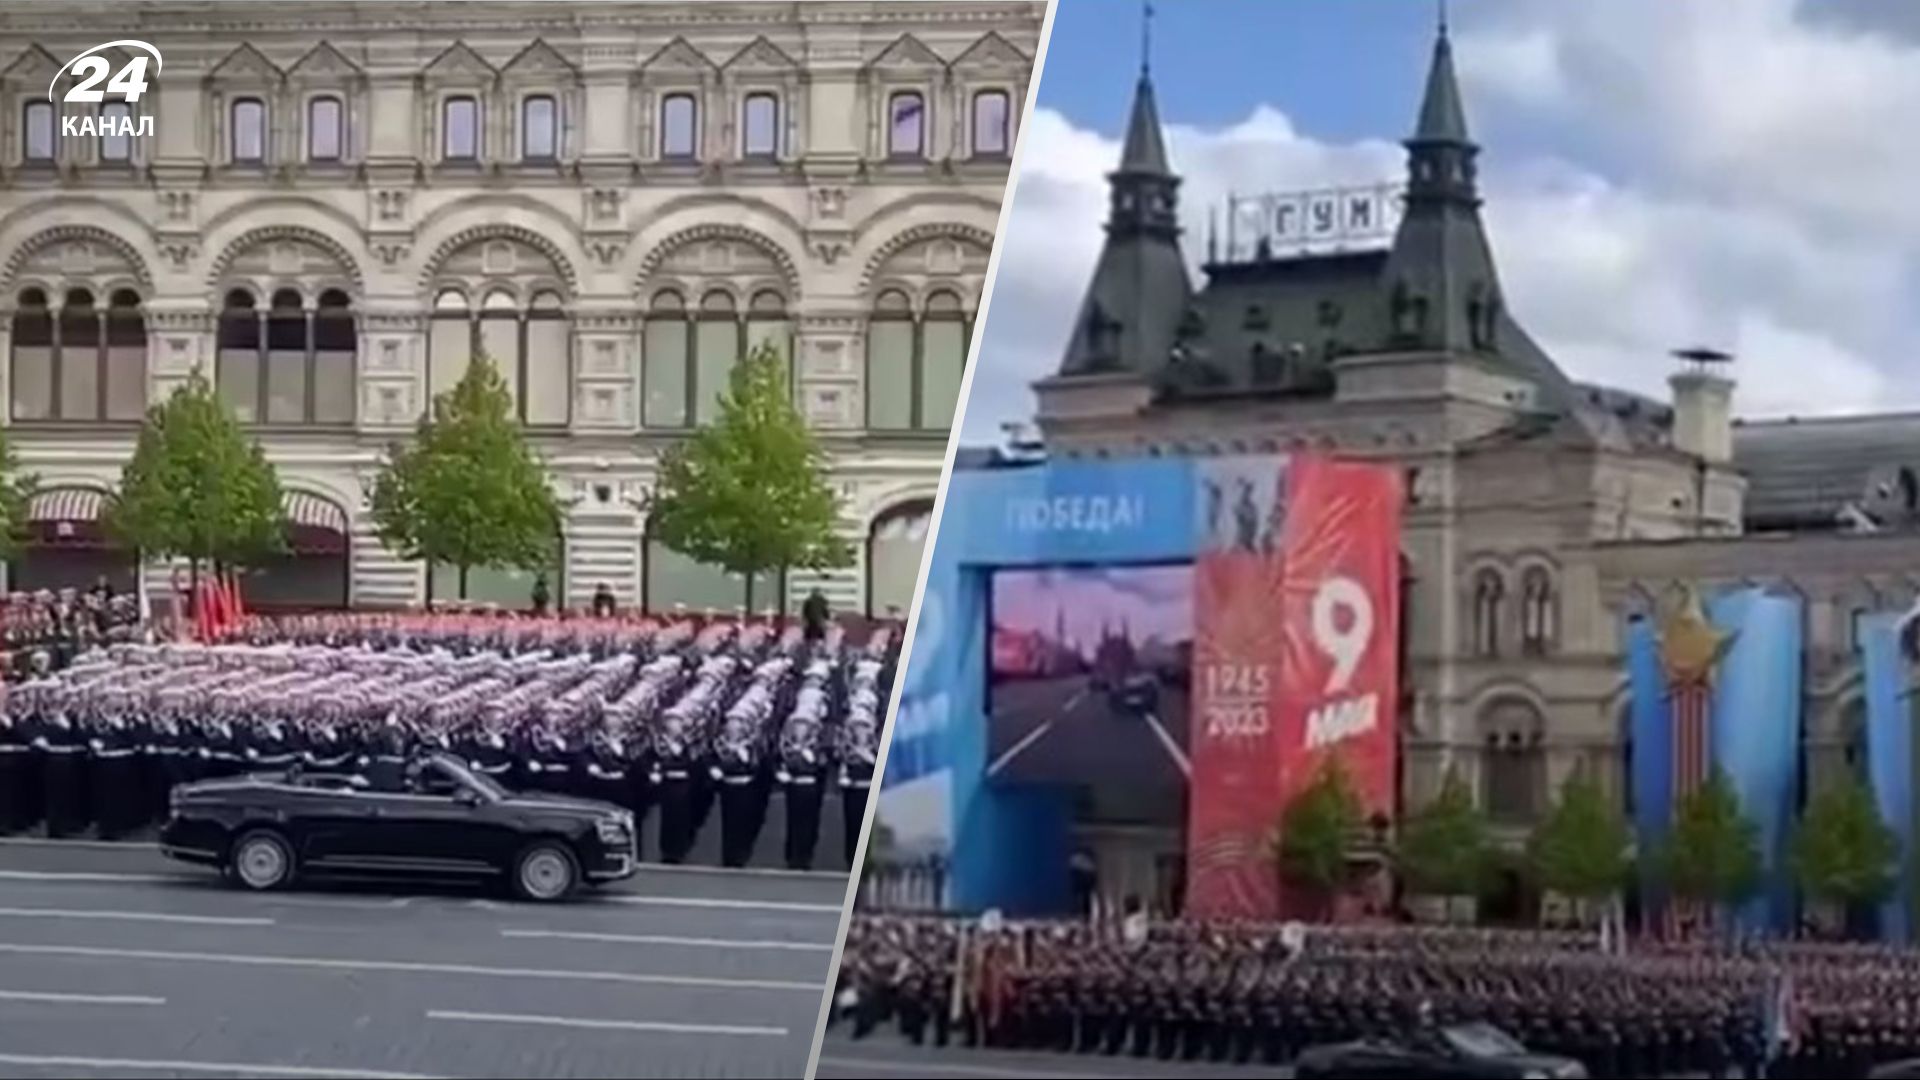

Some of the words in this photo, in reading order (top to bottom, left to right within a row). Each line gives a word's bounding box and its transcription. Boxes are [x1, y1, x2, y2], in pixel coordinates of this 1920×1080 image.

[1276, 199, 1369, 234] ГУМ
[1006, 495, 1144, 534] ПОБЕДА!
[1312, 577, 1373, 695] 9
[1208, 665, 1268, 693] 1945
